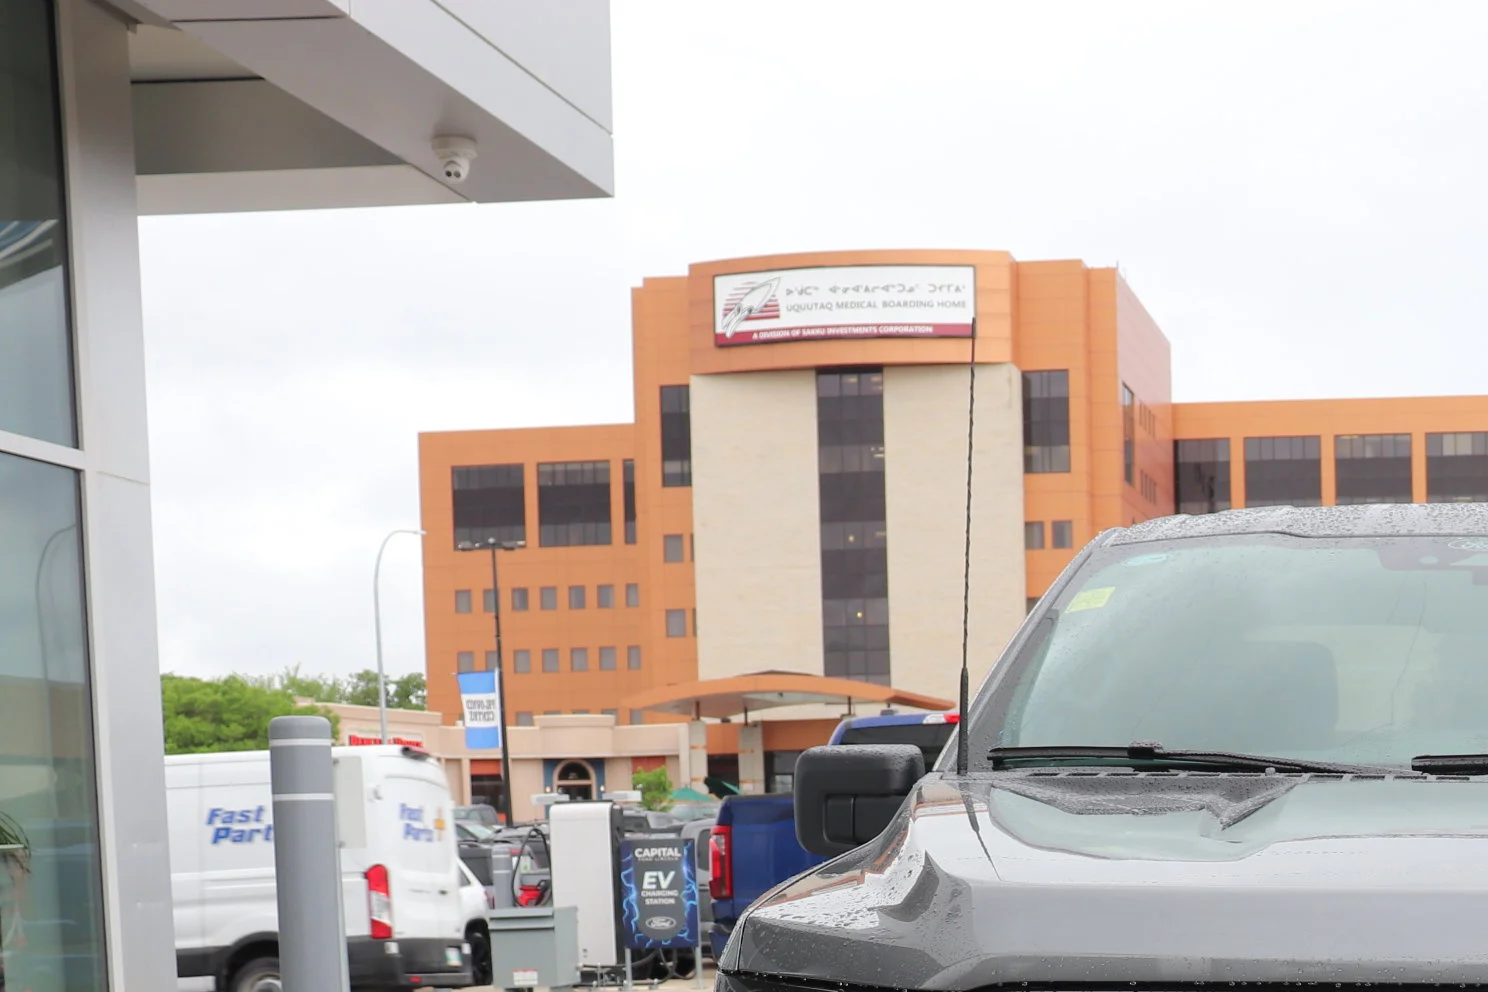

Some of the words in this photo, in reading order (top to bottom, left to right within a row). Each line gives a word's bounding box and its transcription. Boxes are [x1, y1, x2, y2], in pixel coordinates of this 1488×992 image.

[786, 301, 834, 313] UQUUTAQ
[835, 300, 878, 310] MEDICAL
[881, 300, 935, 309] BOARDING
[937, 300, 967, 309] HOME
[206, 805, 265, 825] Fast
[634, 847, 682, 858] CAPITAL
[642, 870, 676, 889] EV
[640, 889, 679, 898] CHARGING
[644, 897, 676, 905] STATION
